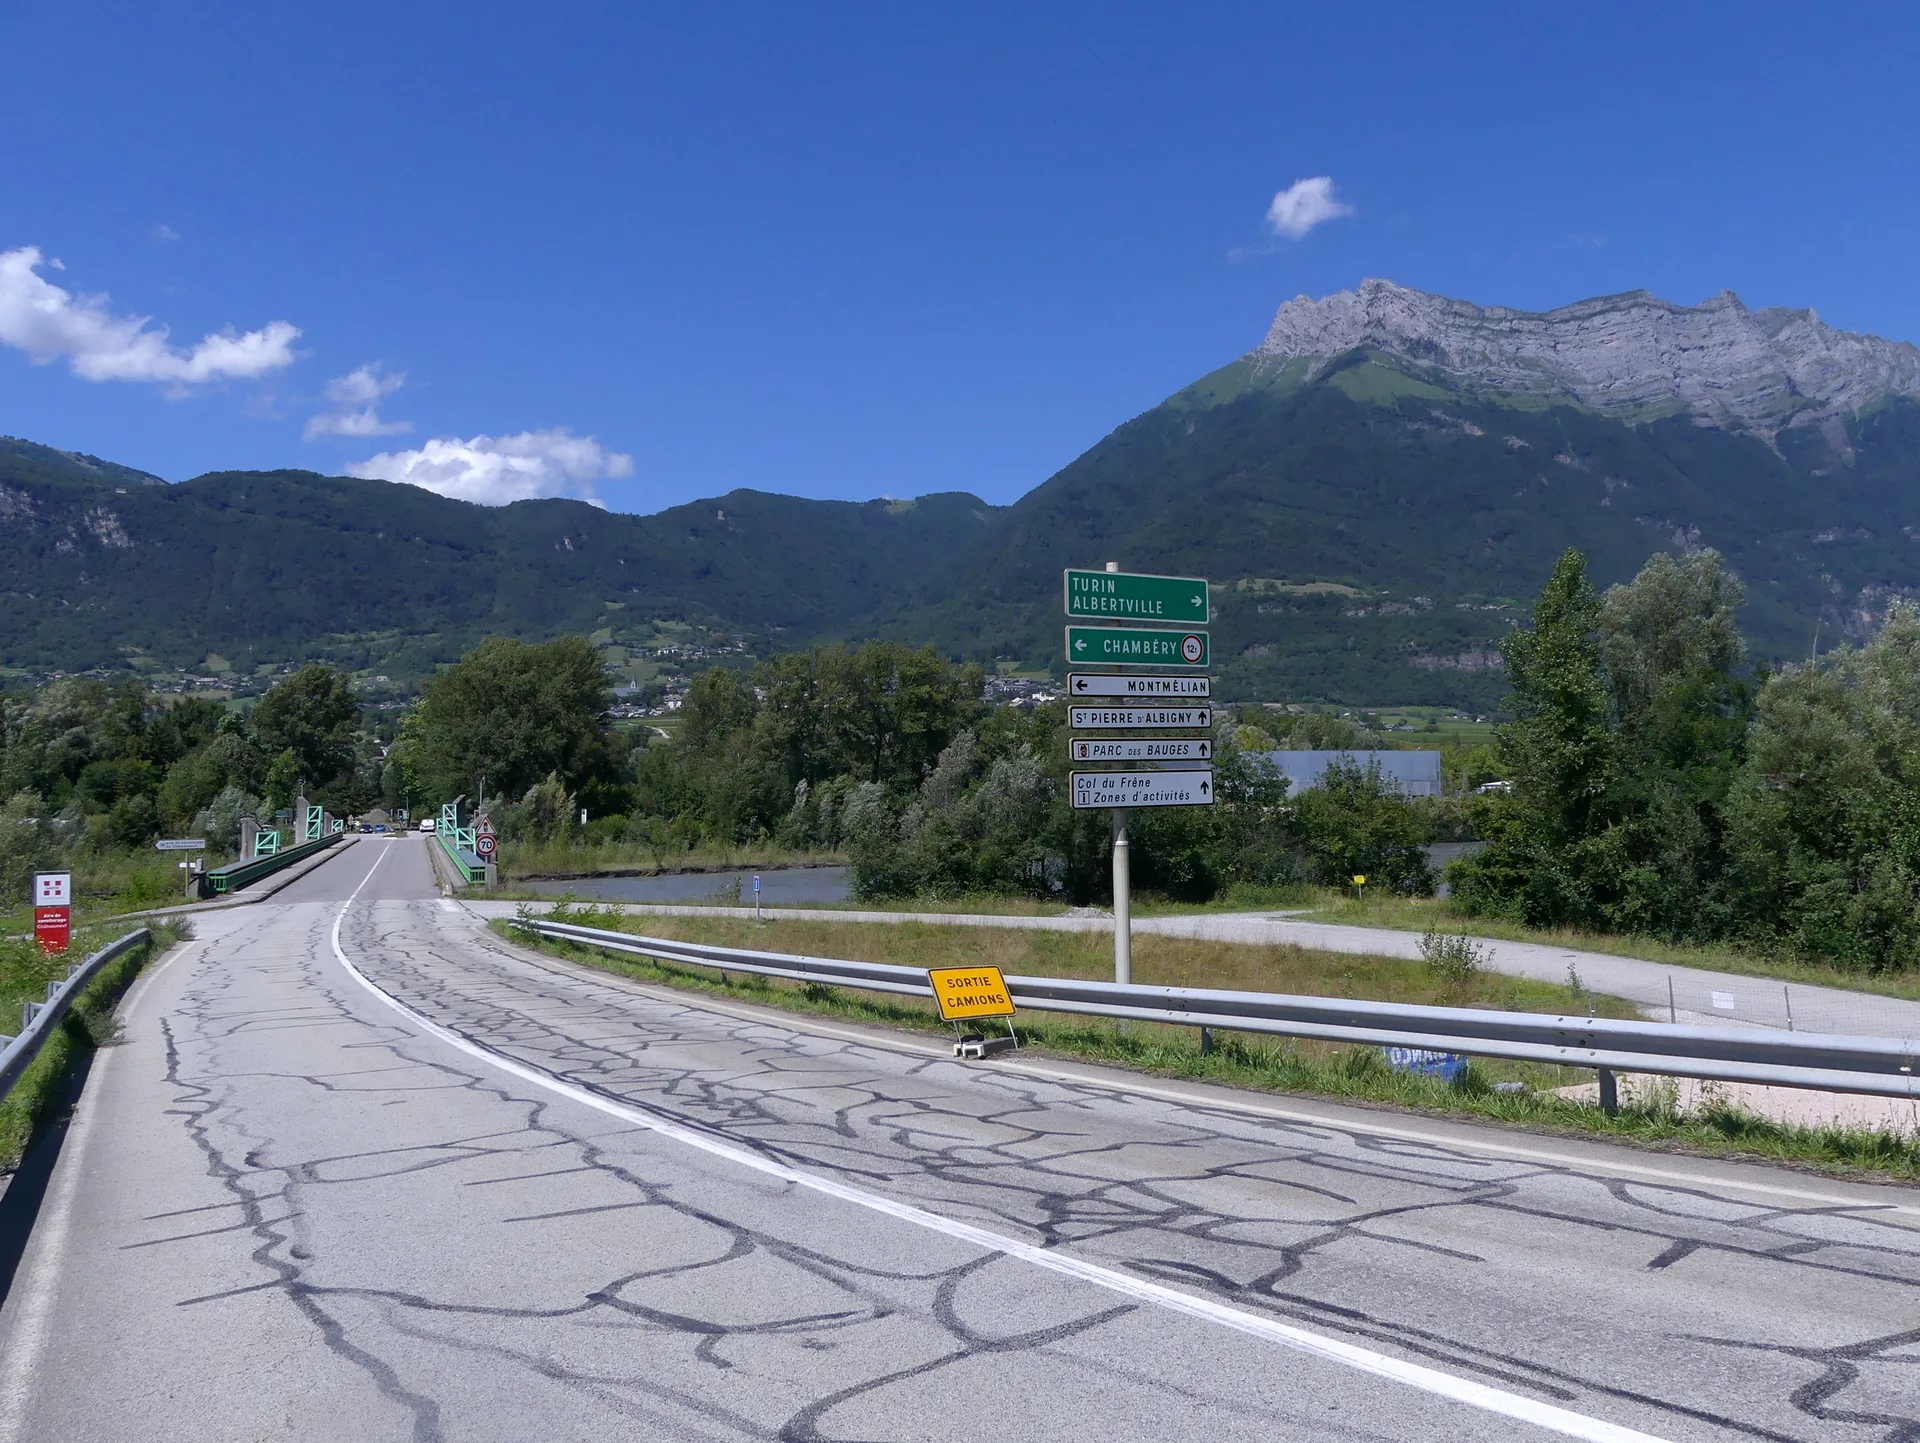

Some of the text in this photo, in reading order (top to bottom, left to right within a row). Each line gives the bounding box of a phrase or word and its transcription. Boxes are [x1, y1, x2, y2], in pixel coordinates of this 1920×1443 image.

[1073, 577, 1115, 593] TURIN
[1073, 596, 1163, 614] ALBERTVILLE
[1104, 639, 1177, 655] CHAMBÉRY
[1128, 680, 1206, 692] MONTMÉLIAN
[1091, 713, 1133, 723] PIERRE
[1093, 745, 1189, 756] PARC DES BAUGES
[1078, 777, 1151, 789] Col du Frêne
[1093, 790, 1190, 803] Zones d'activités
[481, 841, 492, 849] 70
[946, 976, 992, 988] SORTIE
[947, 994, 1005, 1008] CAMIONS
